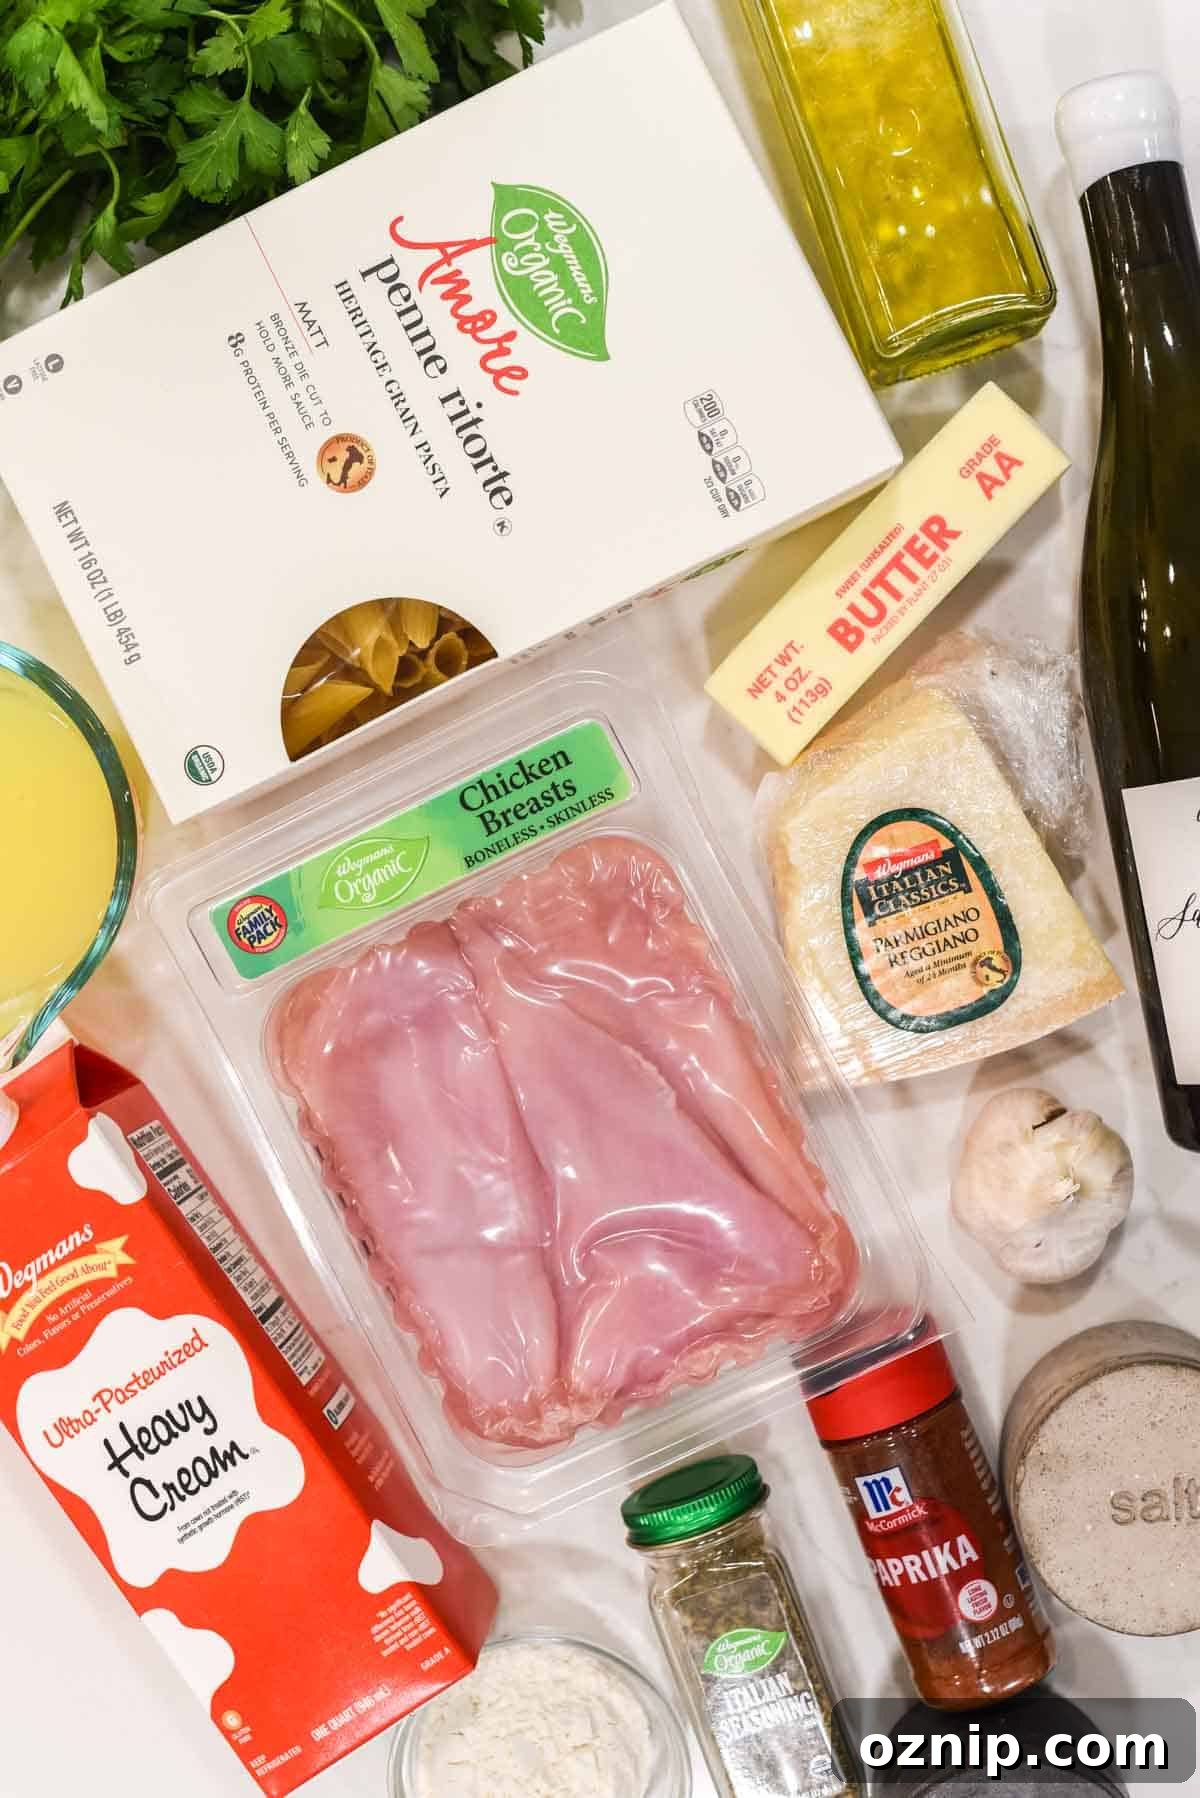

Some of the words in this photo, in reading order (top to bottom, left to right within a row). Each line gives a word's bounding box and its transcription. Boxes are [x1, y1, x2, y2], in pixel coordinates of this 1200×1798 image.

[500, 208, 586, 334] Organic
[544, 208, 598, 305] Wegmans
[294, 302, 328, 347] MATT
[388, 216, 530, 396] Amore
[255, 320, 275, 352] HOLD
[271, 356, 294, 390] MORE
[290, 392, 314, 430] SAUCE
[270, 312, 297, 358] BRONZE
[293, 361, 309, 381] DIE
[305, 384, 322, 405] CUT
[319, 409, 331, 426] TO
[335, 280, 391, 376] HERITAGE
[384, 379, 421, 436] GRAIN
[415, 440, 449, 498] PASTA
[360, 255, 446, 378] penne
[439, 389, 512, 509] ritorte
[239, 360, 269, 410] PROTEIN
[265, 411, 281, 435] PER
[277, 436, 308, 486] SERVING
[699, 393, 720, 418] 200
[959, 434, 1000, 478] GRADE
[975, 451, 1023, 500] AA
[52, 500, 78, 528] NET
[66, 526, 89, 550] WT
[78, 551, 97, 570] 16
[86, 568, 107, 589] OZ
[835, 570, 860, 598] SWEET
[859, 523, 904, 570] (UNSALTED)
[93, 587, 114, 602] (1
[827, 515, 960, 652] BUTTER
[102, 601, 126, 626] LB)
[116, 627, 138, 652] 454
[123, 652, 141, 665] g
[746, 664, 777, 698] NET
[773, 639, 803, 666] WT.
[774, 690, 786, 703] 4
[783, 666, 810, 691] OZ.
[787, 677, 832, 724] (113g)
[200, 750, 219, 775] USDA
[459, 750, 571, 811] Chicken
[464, 825, 537, 867] BONELESS
[546, 787, 614, 827] SKINLESS
[473, 779, 583, 836] Breasts
[333, 850, 414, 905] Organic
[335, 843, 394, 877] Wegmans
[868, 863, 952, 900] ITALIAN
[876, 851, 935, 879] Wegmans
[872, 878, 960, 917] CLASSICS
[236, 904, 275, 941] FAMILY
[248, 915, 284, 950] PACK
[873, 907, 980, 954] PARMIGIANO
[38, 1282, 54, 1302] Feel
[55, 1268, 79, 1287] Good
[46, 1312, 60, 1324] No
[71, 1311, 81, 1321] or
[44, 1328, 208, 1449] Ultra-Pasteurized
[103, 1396, 217, 1486] Heavy
[129, 1439, 250, 1522] Cream
[1110, 1472, 1200, 1525] salt
[866, 1504, 928, 1534] McCormick
[870, 1533, 979, 1589] PAPRIKA
[985, 1627, 1000, 1644] 2.12
[997, 1621, 1011, 1637] OZ
[311, 1723, 330, 1742] ONE
[327, 1706, 355, 1731] QUART
